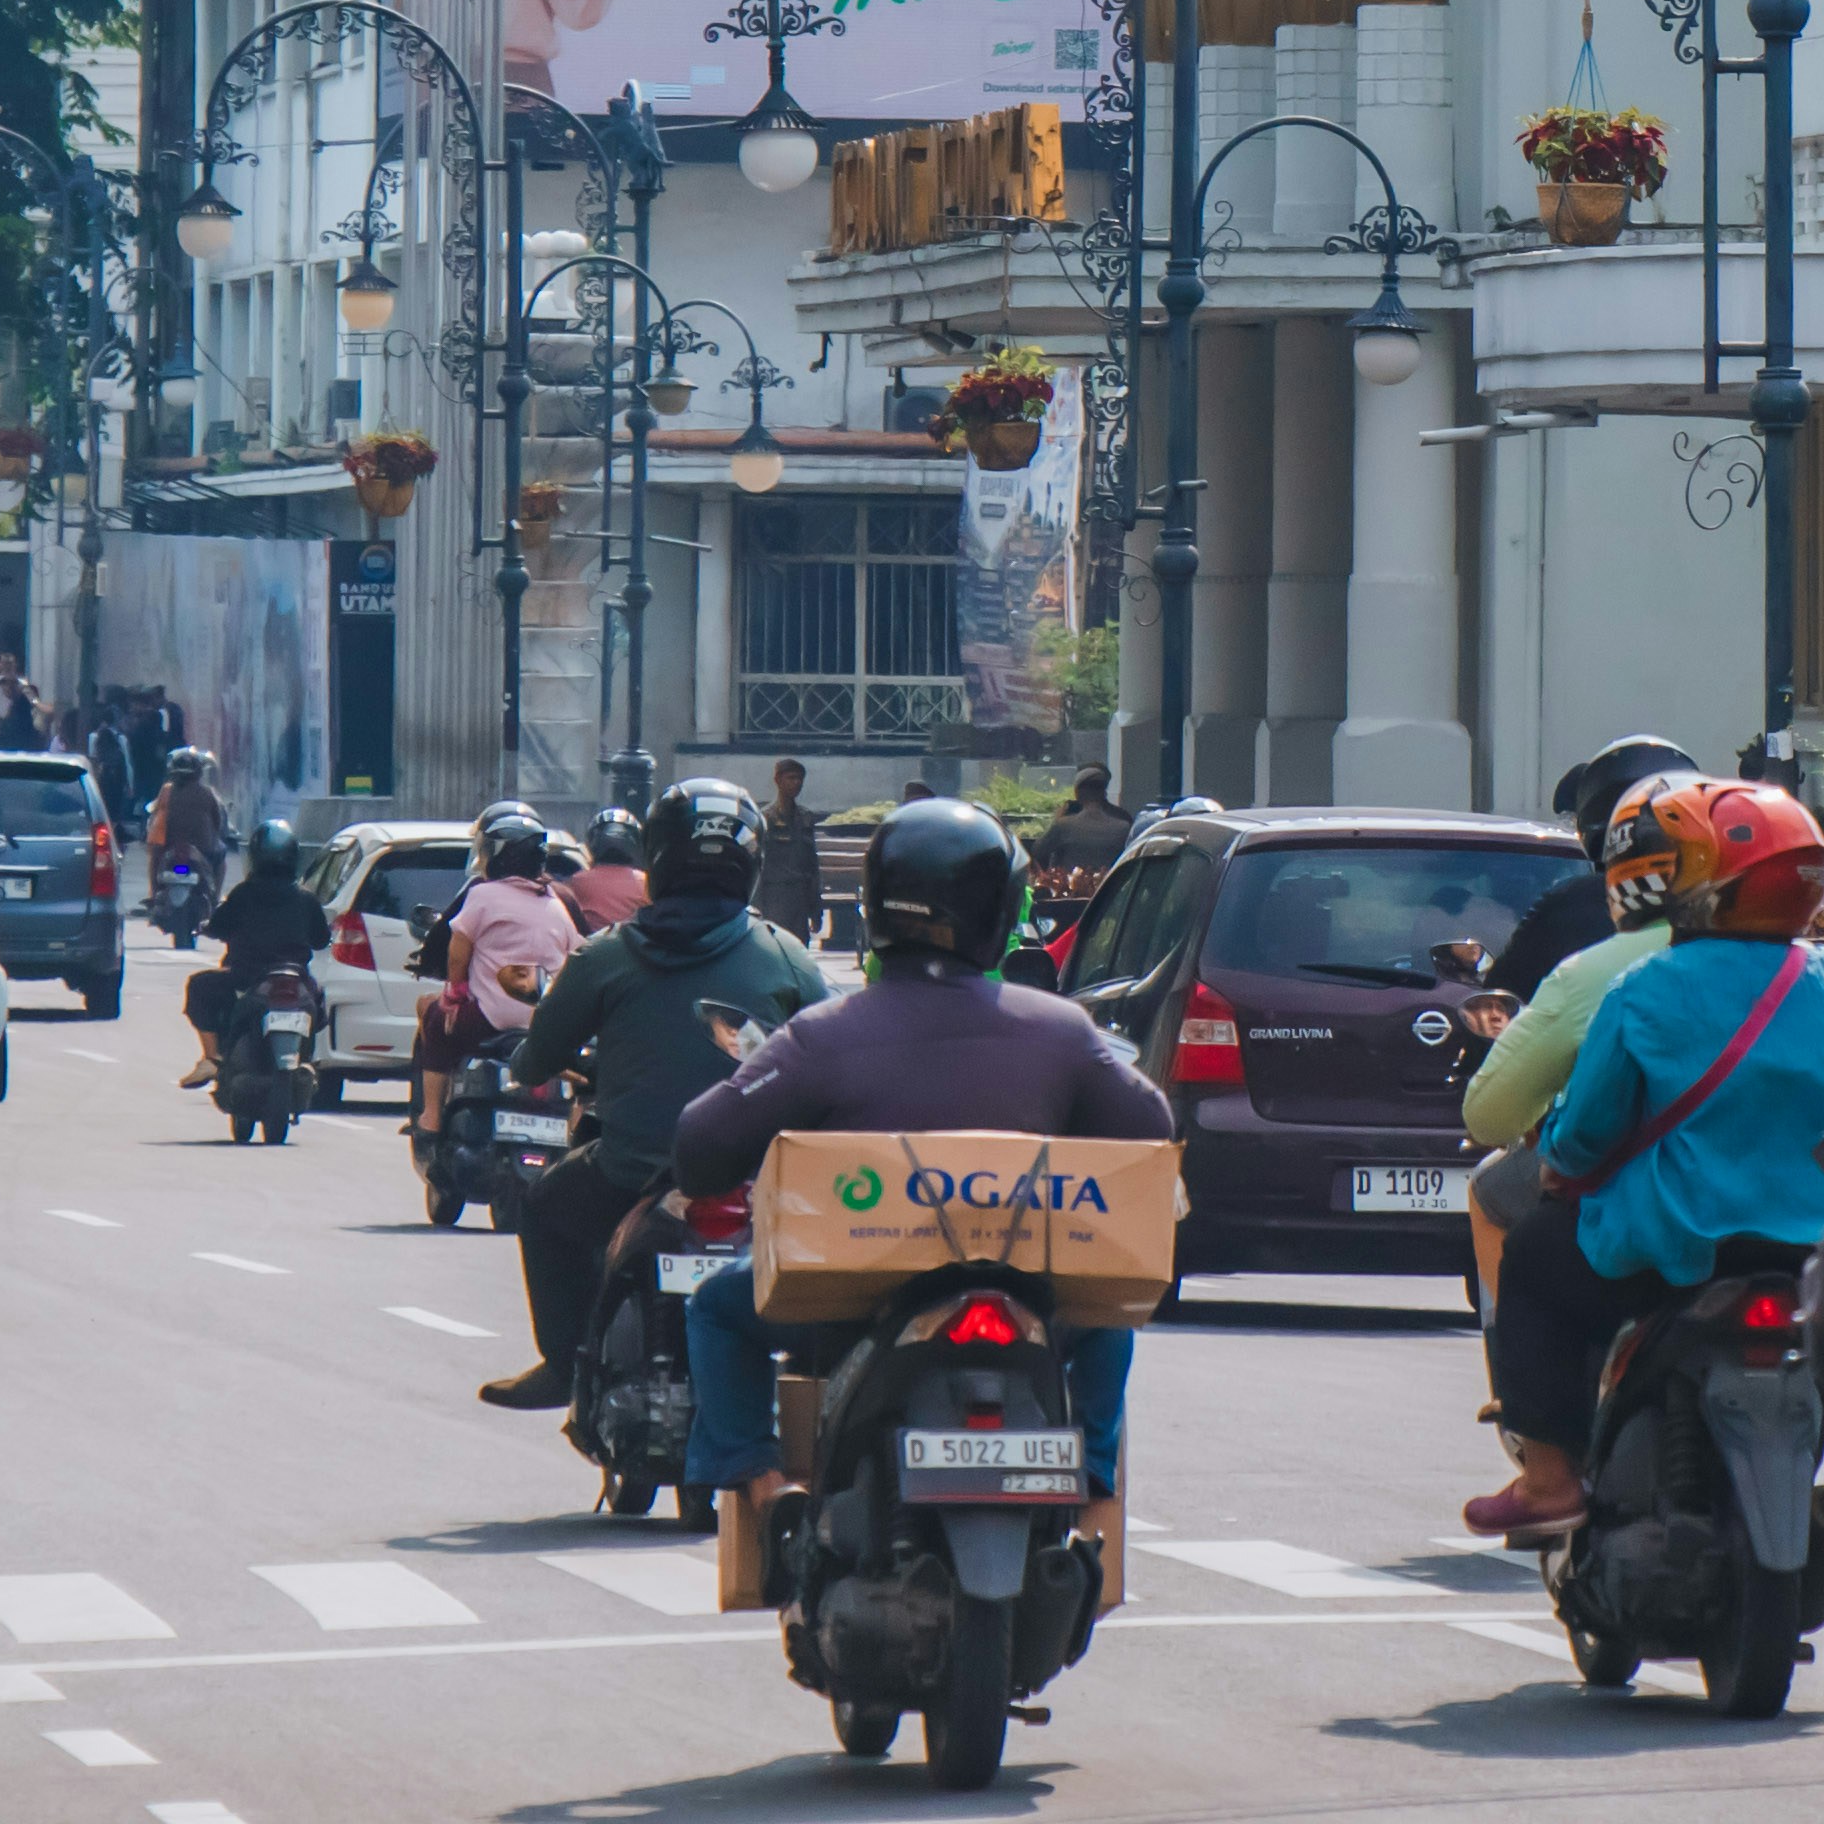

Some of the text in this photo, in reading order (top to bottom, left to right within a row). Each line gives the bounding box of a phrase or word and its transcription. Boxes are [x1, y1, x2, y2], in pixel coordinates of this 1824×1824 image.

[983, 82, 1044, 94] Download
[1249, 1027, 1333, 1040] GRAND LIVINA
[905, 1167, 1109, 1214] OGATA
[1356, 1170, 1445, 1196] D 1109
[662, 1257, 674, 1272] D
[911, 1439, 1073, 1465] D 5022 UEW
